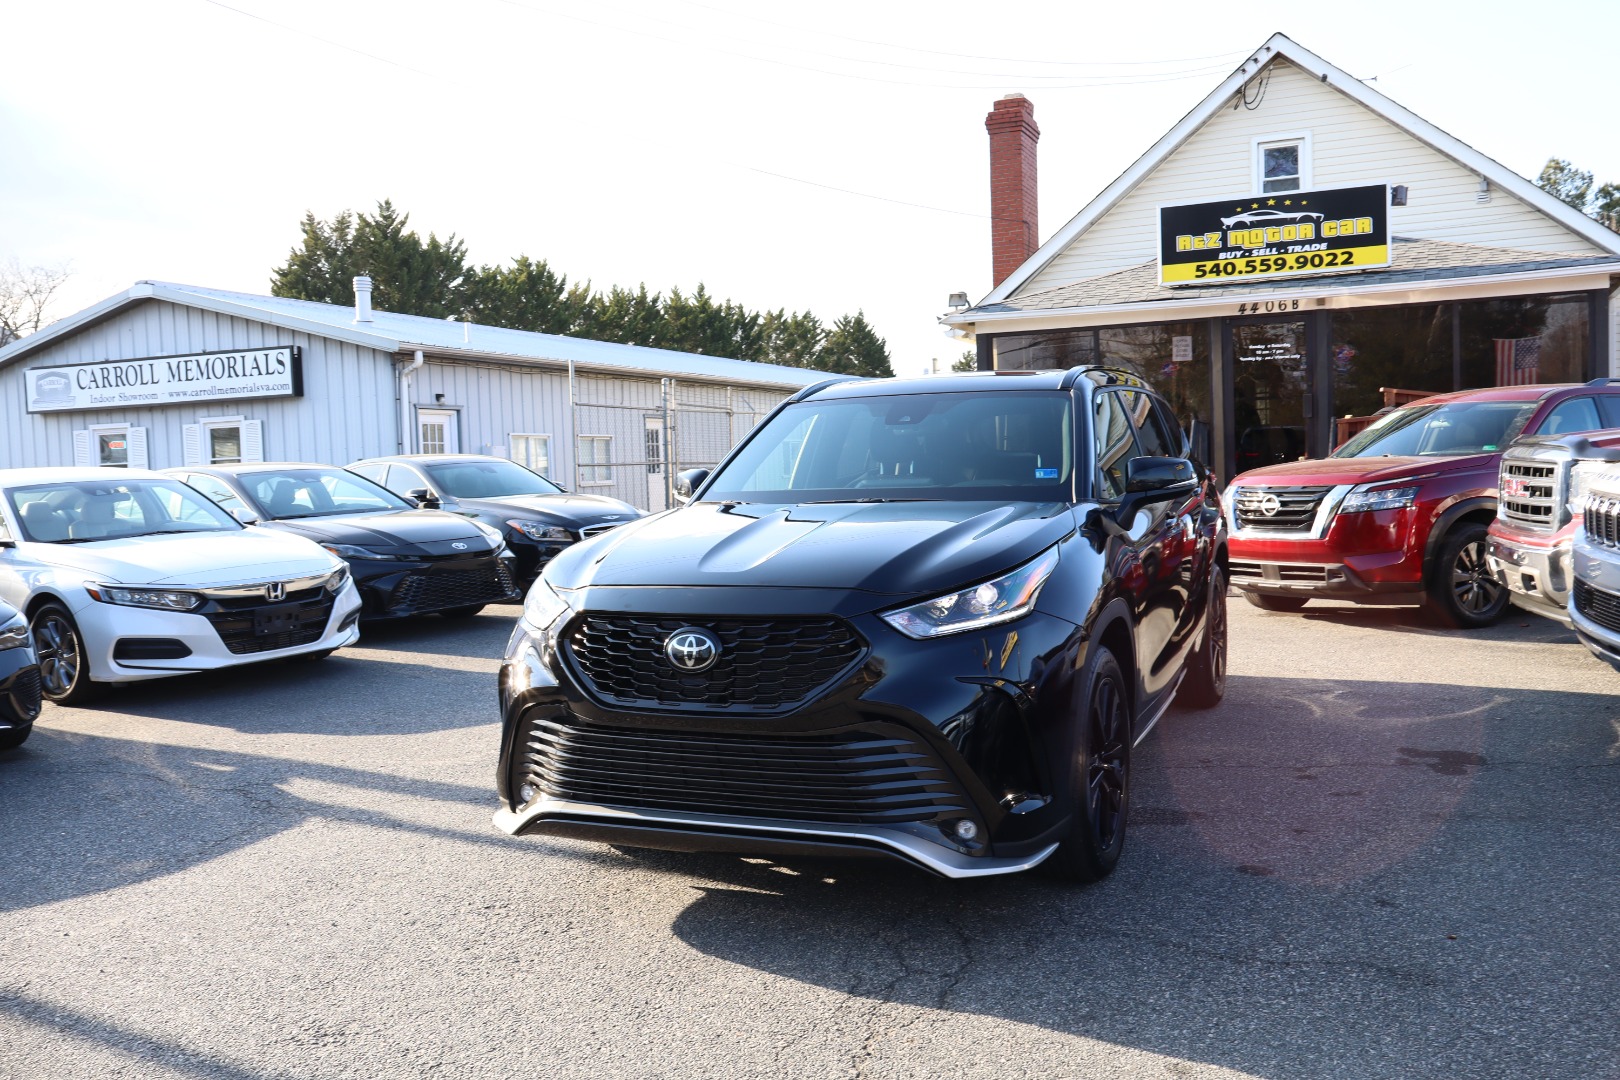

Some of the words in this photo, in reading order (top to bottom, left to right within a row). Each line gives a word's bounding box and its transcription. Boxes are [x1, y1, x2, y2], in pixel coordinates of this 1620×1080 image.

[1218, 250, 1244, 259] BUY
[1251, 247, 1279, 257] SELL
[1286, 242, 1328, 254] TRADE
[1195, 251, 1354, 278] 540.559.9022
[77, 363, 160, 390] CARROLL
[166, 352, 286, 383] MEMORIALS
[90, 394, 116, 404] Indoor
[118, 392, 159, 402] Showroom
[168, 382, 290, 398] www.carrollmemorialsva.com
